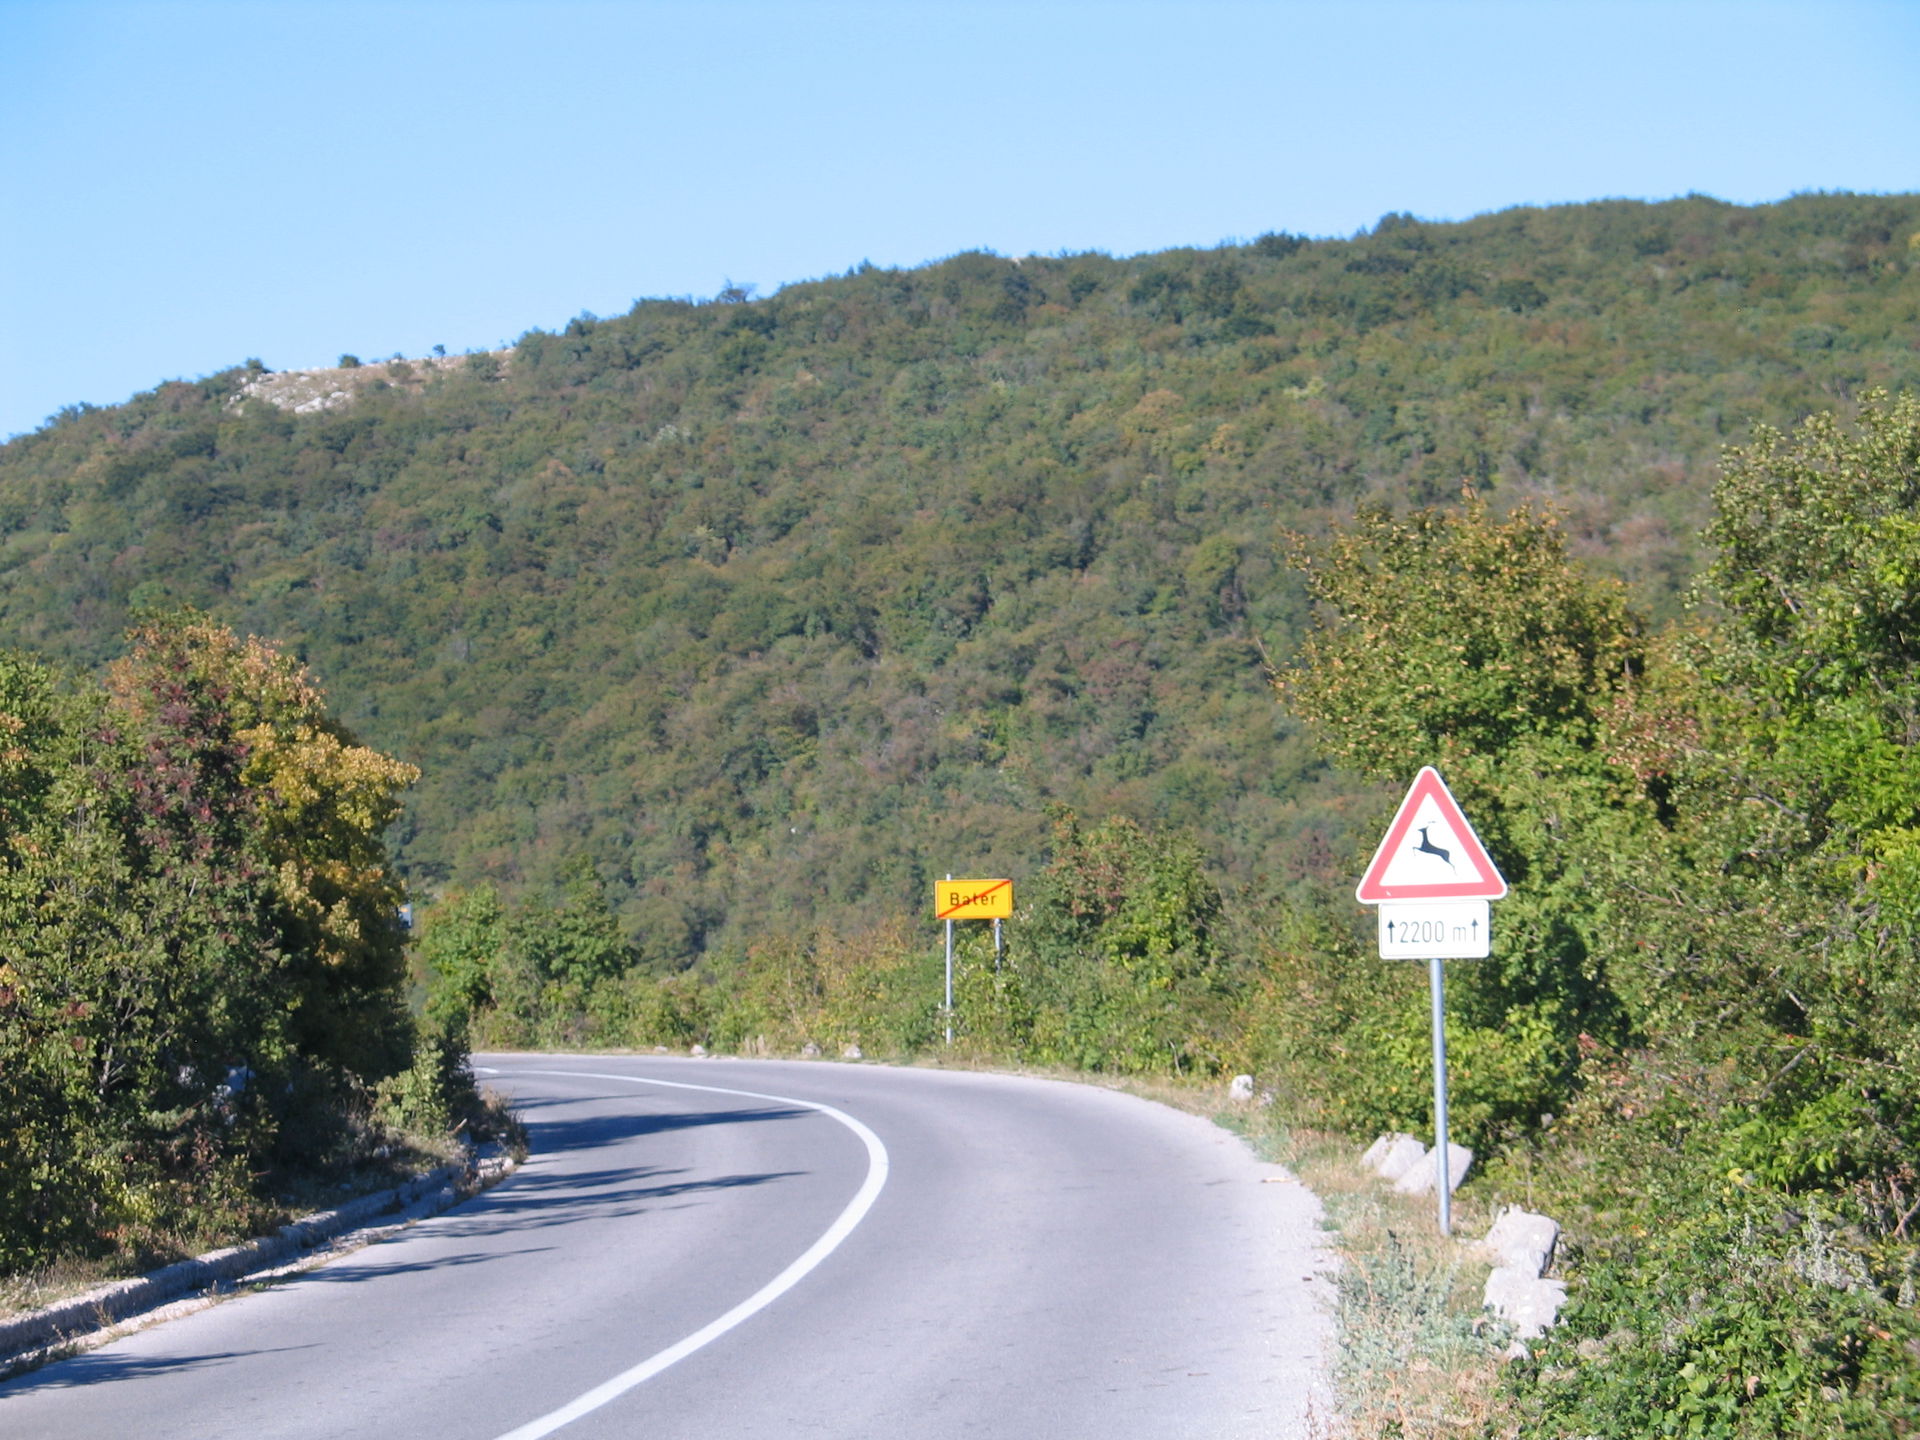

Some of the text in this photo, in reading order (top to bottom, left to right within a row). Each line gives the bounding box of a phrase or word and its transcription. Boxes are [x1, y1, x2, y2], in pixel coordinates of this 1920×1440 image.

[950, 892, 997, 906] Bater
[1399, 921, 1467, 943] 2200 m
